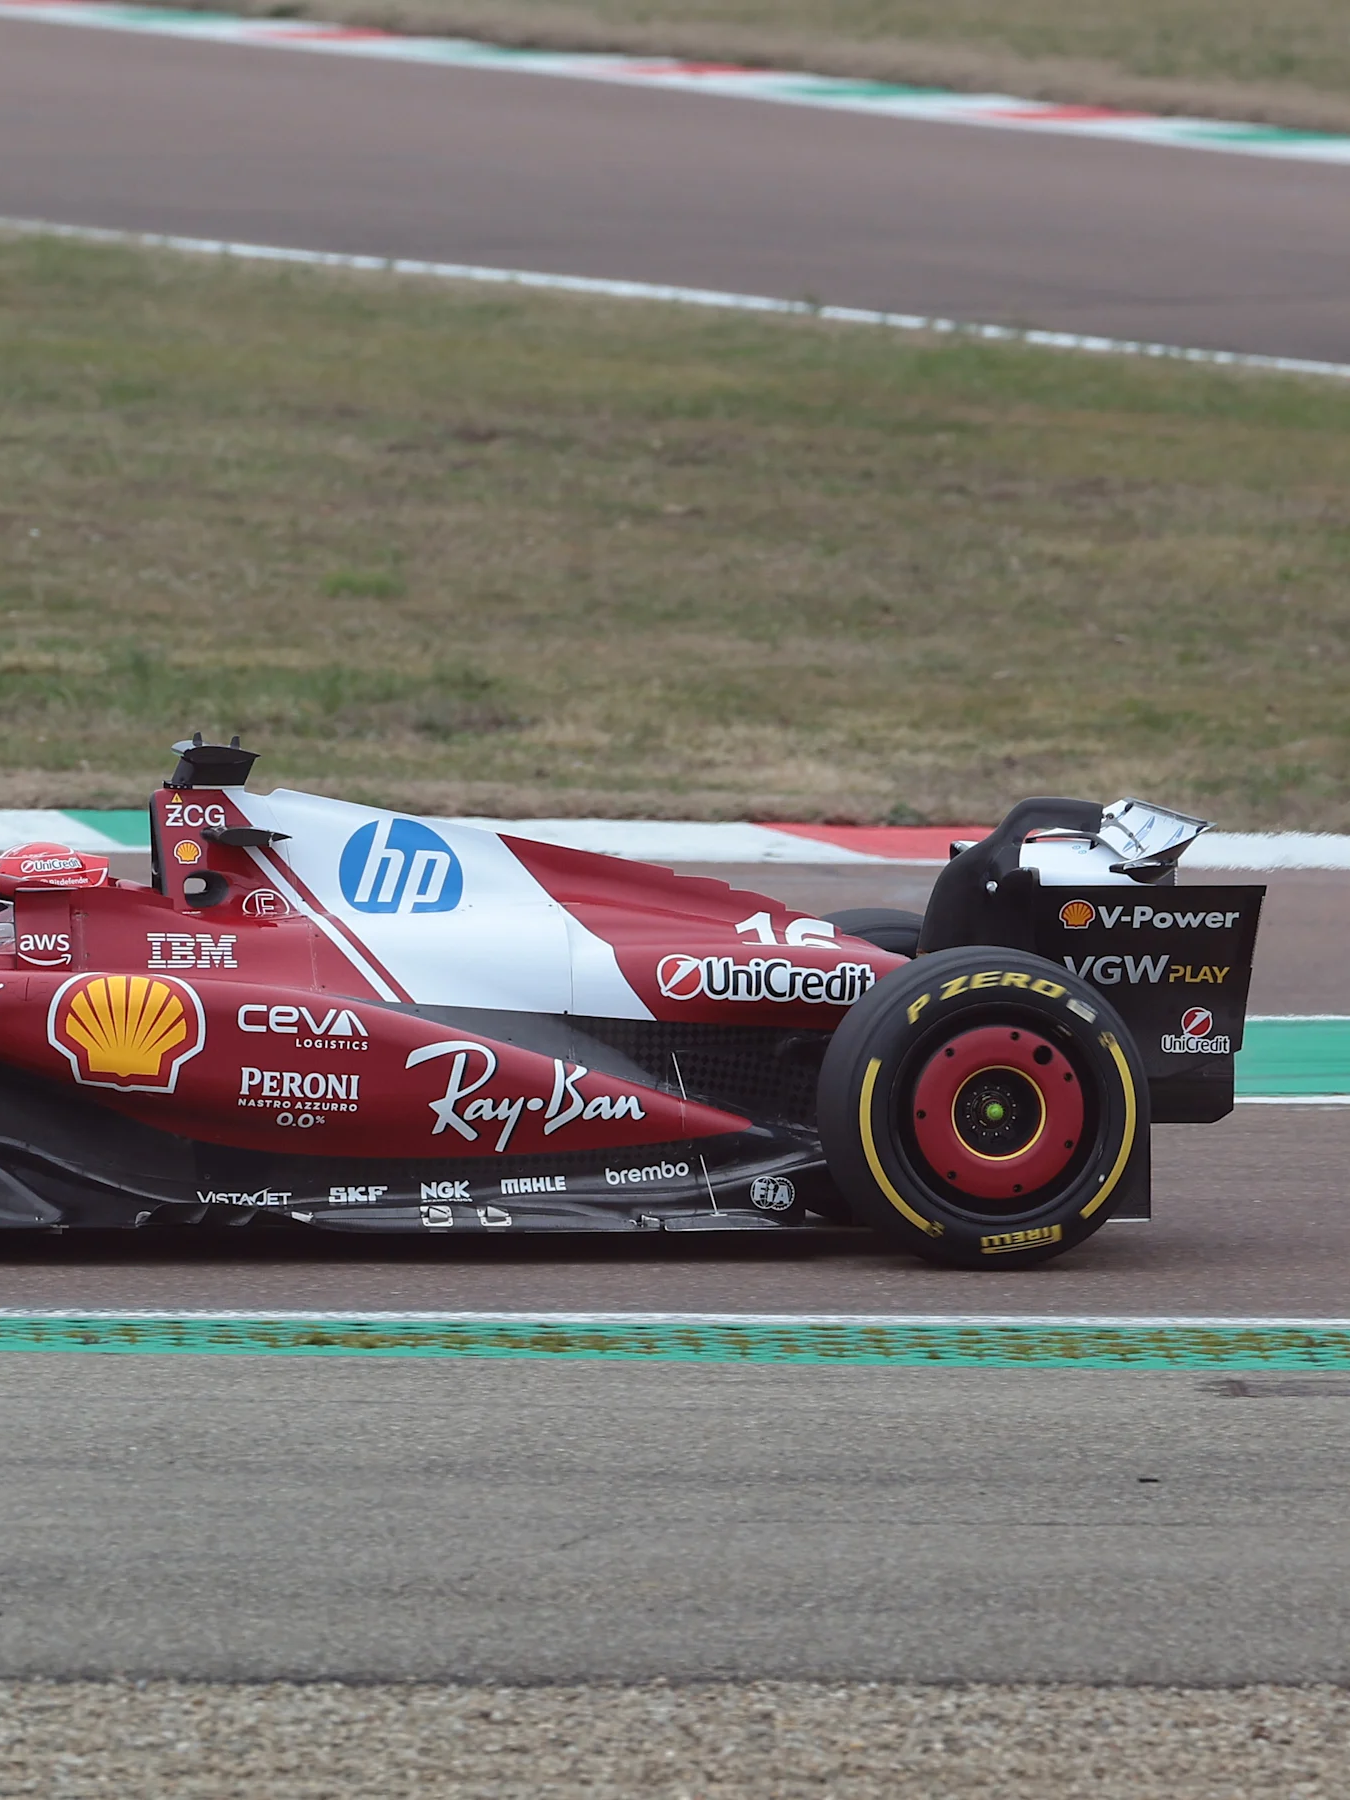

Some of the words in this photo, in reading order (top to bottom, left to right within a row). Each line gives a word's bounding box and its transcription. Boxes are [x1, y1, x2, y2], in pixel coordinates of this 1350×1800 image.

[165, 804, 226, 828] ZCG
[35, 858, 82, 872] UniCredit
[353, 818, 451, 914] hp
[1097, 905, 1240, 929] V-Power
[19, 933, 71, 952] aws
[146, 932, 239, 969] IBM
[704, 957, 872, 1003] UniCredit
[1062, 954, 1170, 985] VGW
[1169, 965, 1230, 984] PLAY
[906, 993, 932, 1025] P
[939, 970, 1067, 1001] ZERO
[295, 1038, 369, 1051] LOGISTICS
[1162, 1034, 1230, 1053] UniCredit
[239, 1066, 360, 1100] PERONI
[237, 1098, 291, 1109] NASTRO
[294, 1101, 358, 1112] AZZURRO
[276, 1111, 326, 1128] 0.0%
[604, 1160, 690, 1186] brembo
[328, 1185, 389, 1203] SKF
[420, 1179, 471, 1200] NGK
[500, 1175, 567, 1195] MAHLE
